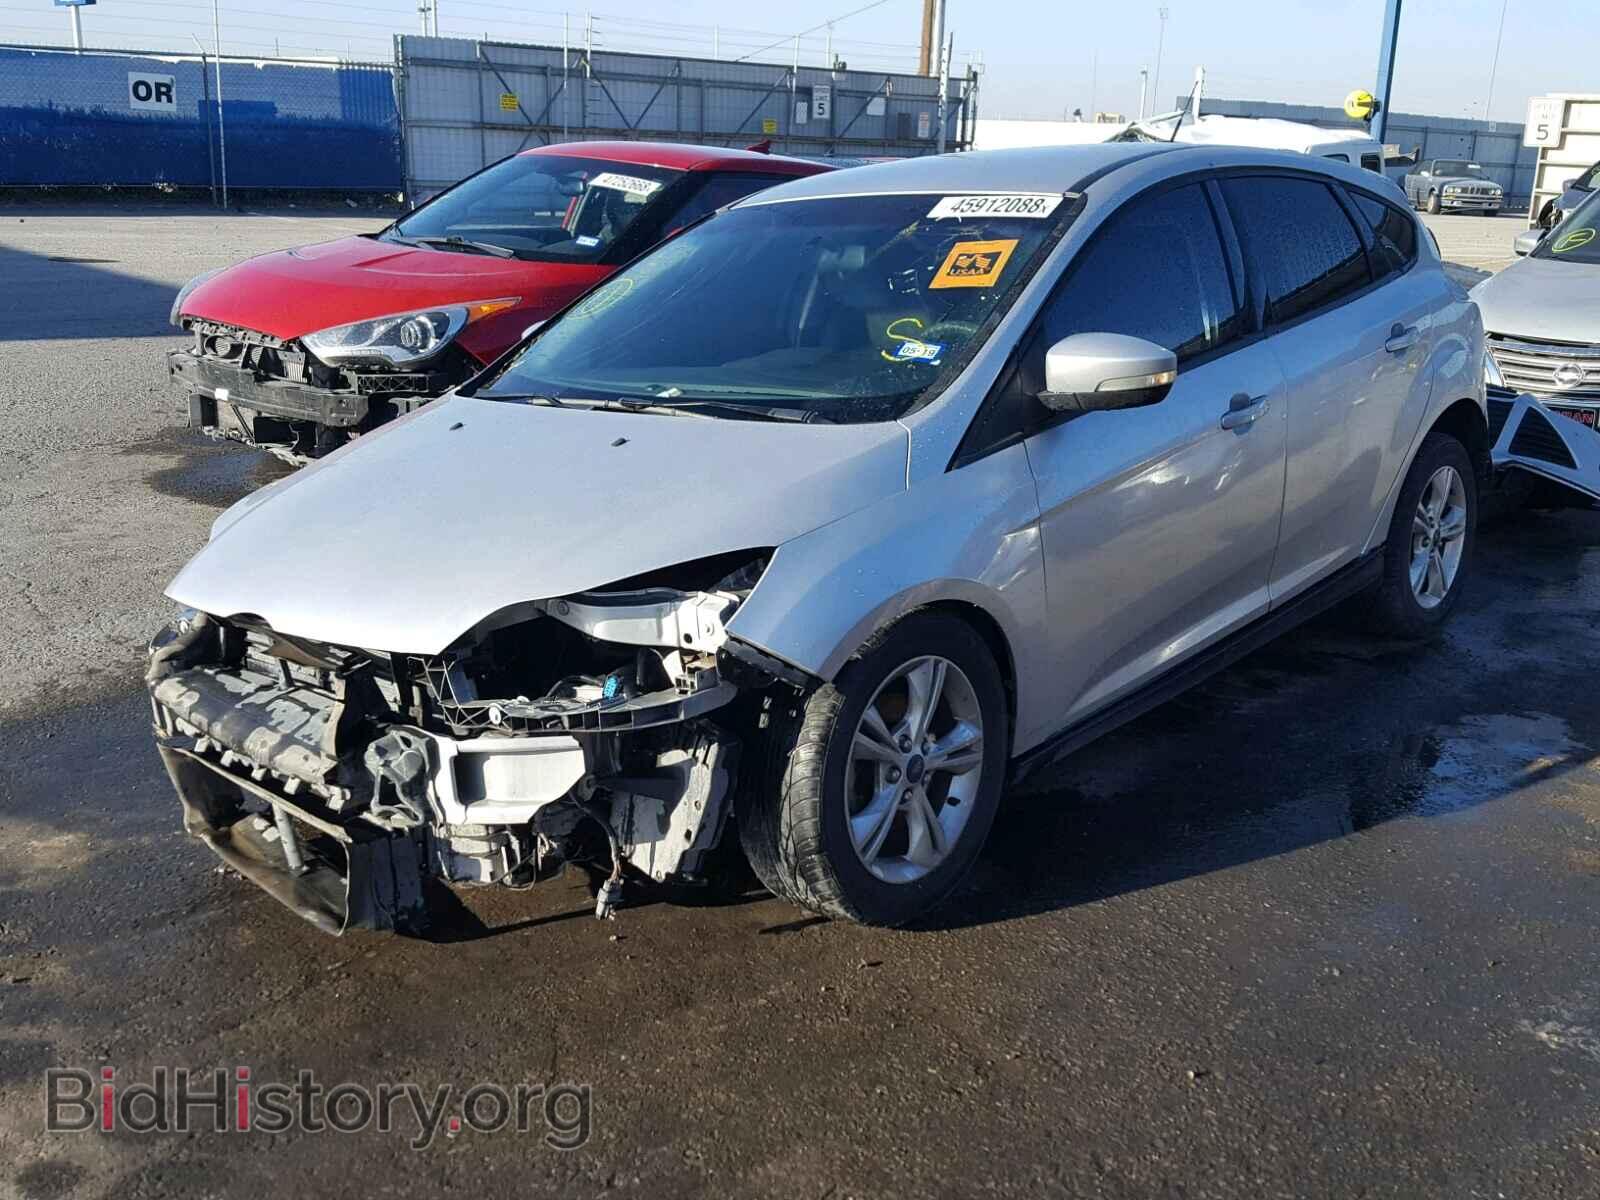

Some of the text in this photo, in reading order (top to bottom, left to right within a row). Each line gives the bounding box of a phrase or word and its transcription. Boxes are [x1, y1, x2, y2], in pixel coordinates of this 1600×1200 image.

[132, 80, 173, 104] OR
[817, 103, 825, 116] 5
[1536, 124, 1549, 141] 5
[950, 267, 986, 275] USAA
